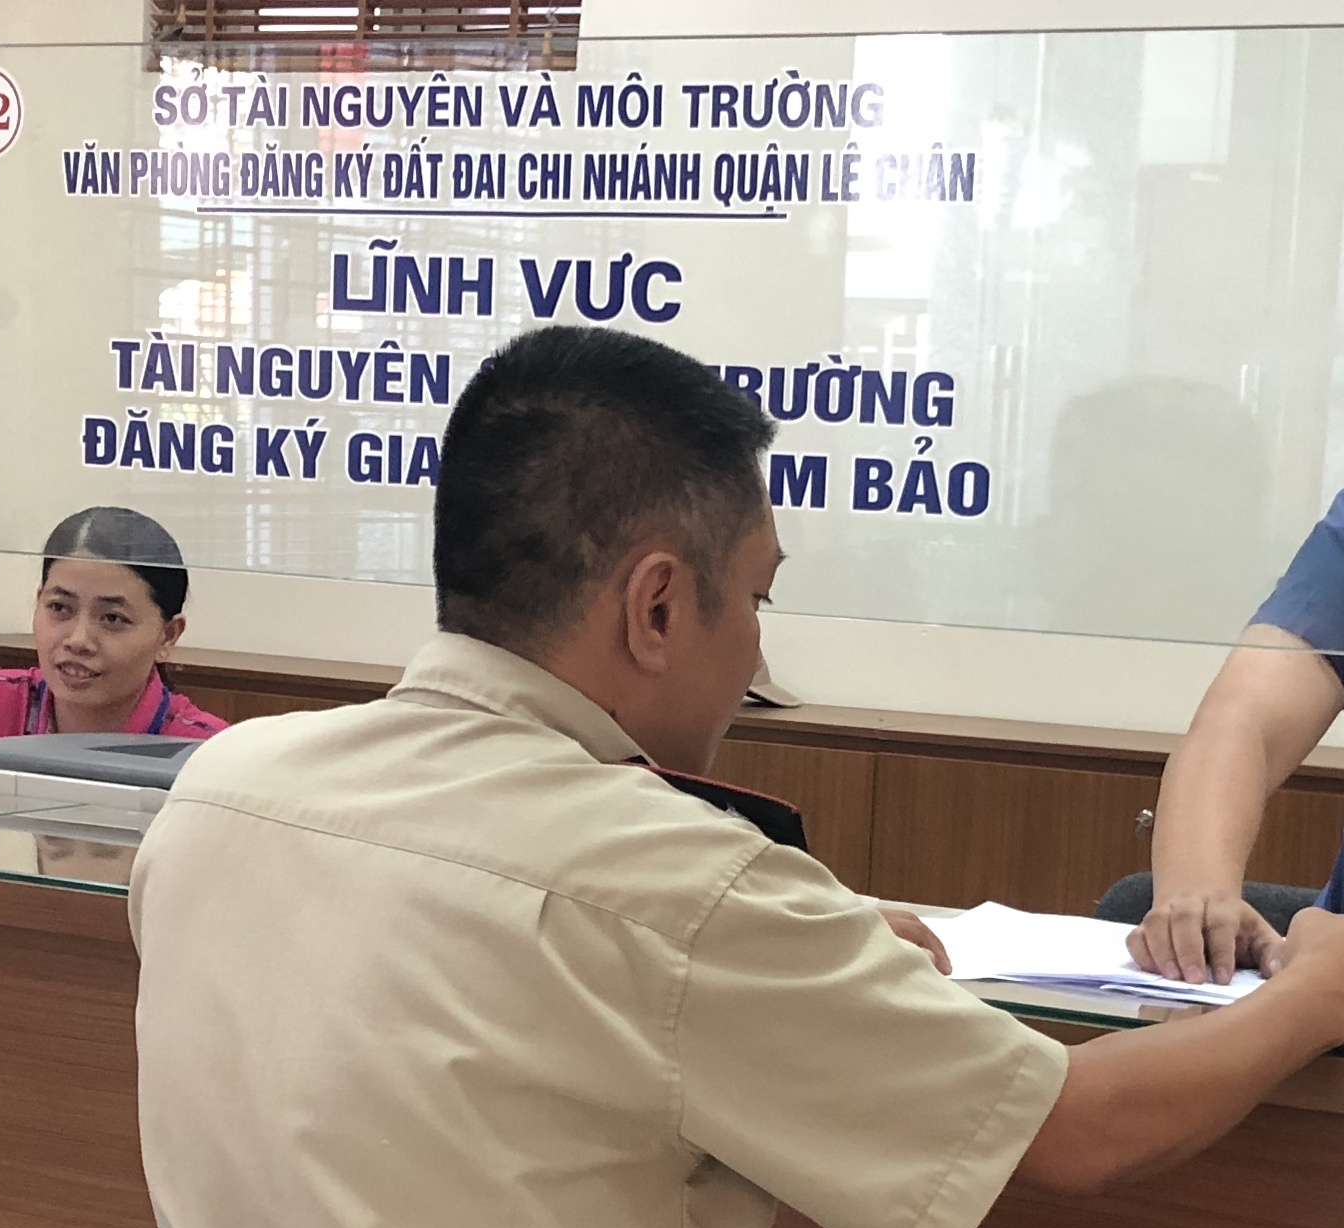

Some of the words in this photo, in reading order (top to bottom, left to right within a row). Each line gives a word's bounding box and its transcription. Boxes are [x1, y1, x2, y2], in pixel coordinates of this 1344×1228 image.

[153, 67, 209, 128] SỞ
[220, 74, 289, 128] TÀI
[301, 72, 484, 129] NGUYÊN
[498, 71, 561, 128] VÀ
[576, 71, 663, 129] MÔI
[681, 69, 885, 129] TRƯỜNG
[62, 141, 121, 196] VĂN
[129, 140, 231, 197] PHÒNG
[239, 142, 324, 198] ĐĂNG
[334, 143, 374, 199] KÝ
[382, 135, 443, 199] ĐẤT
[452, 153, 506, 200] ĐAI
[517, 152, 573, 200] CHI
[582, 141, 701, 201] NHÁNH
[713, 141, 810, 212] QUẬN
[820, 141, 862, 202] LÊ
[874, 141, 976, 202] CHÂN
[331, 238, 495, 317] LĨNH
[110, 331, 196, 393] TÀI
[215, 339, 451, 405] NGUYÊN
[706, 353, 956, 428] RƯỜNG
[82, 408, 235, 474] ĐĂNG
[255, 417, 328, 479] KÝ
[346, 432, 441, 487] GIA
[852, 435, 991, 518] BẢO
